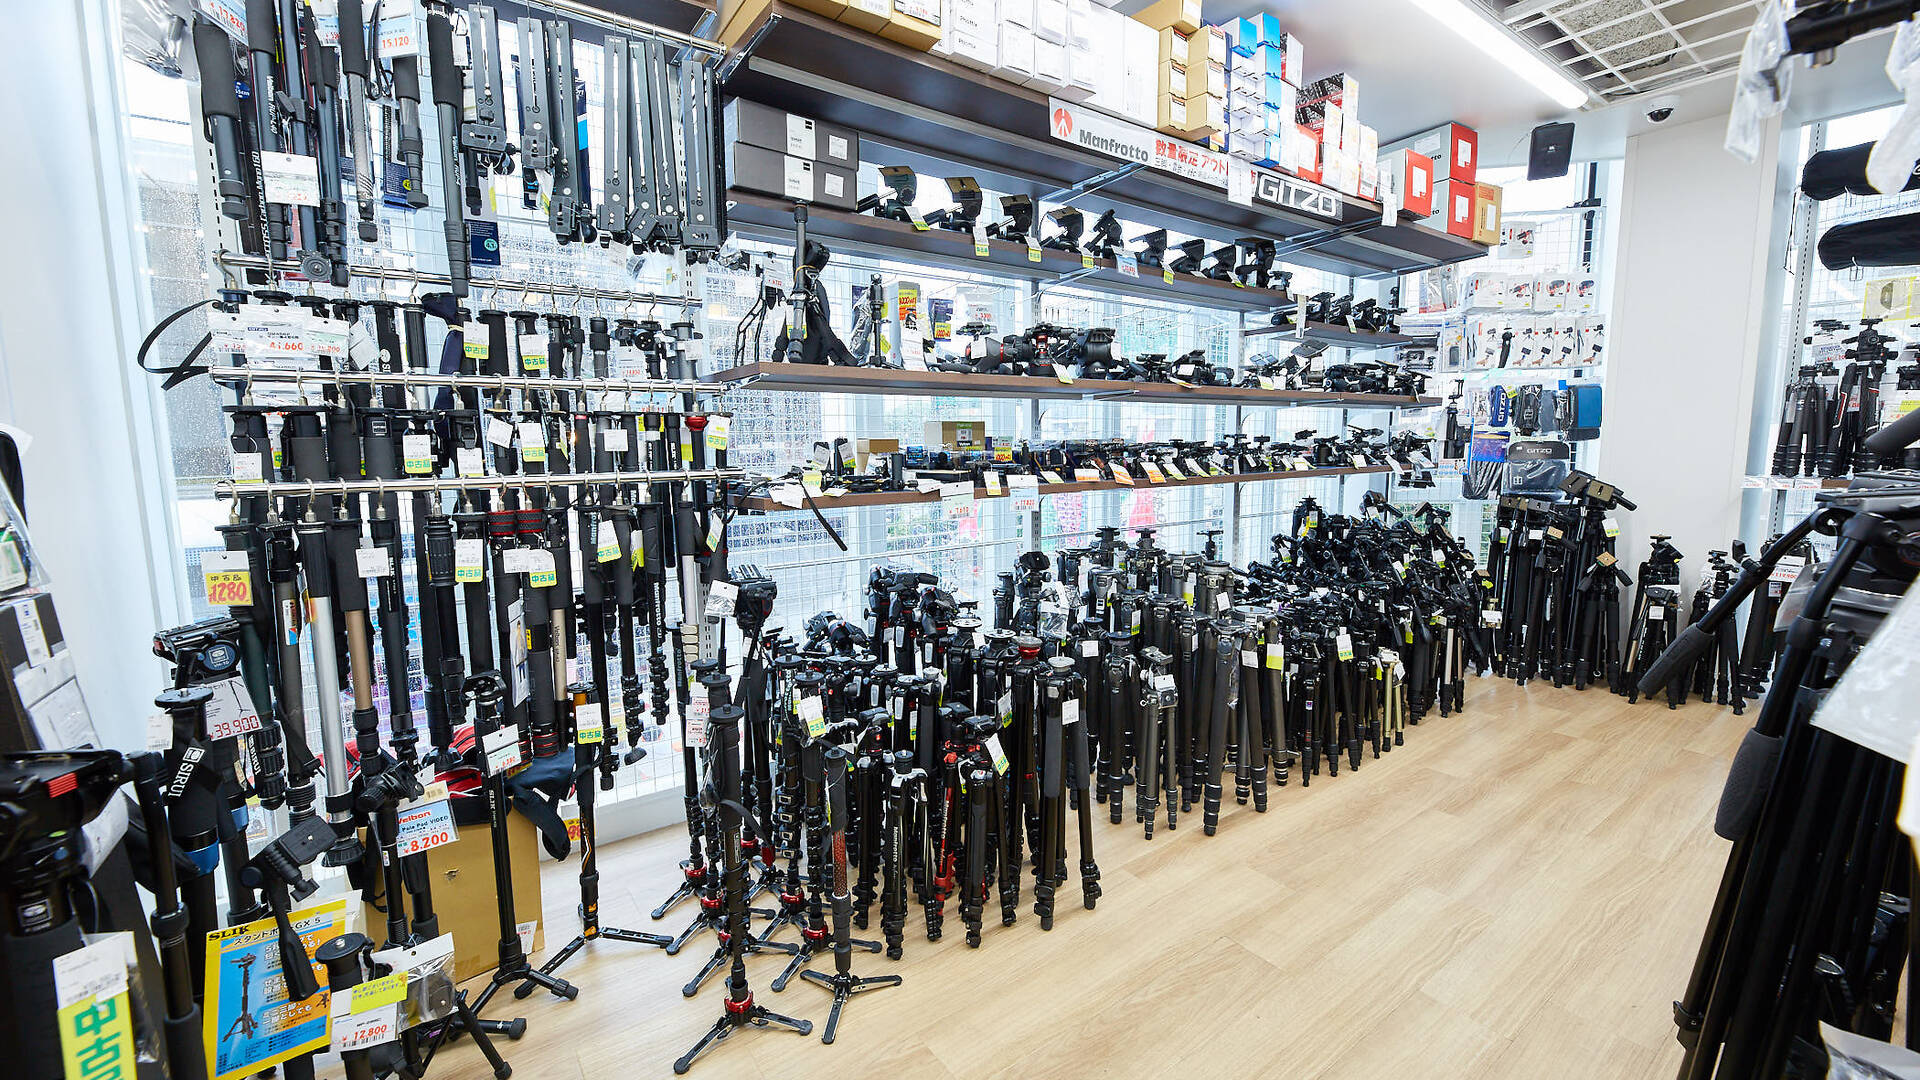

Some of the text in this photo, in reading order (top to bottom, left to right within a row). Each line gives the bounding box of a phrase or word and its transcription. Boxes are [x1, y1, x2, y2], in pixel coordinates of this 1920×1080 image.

[1079, 129, 1149, 163] Manfrotto
[1259, 174, 1337, 217] GITZO
[1497, 392, 1507, 422] GITZO
[405, 459, 431, 469] 中古品
[456, 568, 482, 579] 中古品
[530, 572, 556, 584] 中古品
[577, 729, 602, 740] 中古品
[167, 762, 194, 799] SIRUI
[207, 925, 250, 943] SLIK
